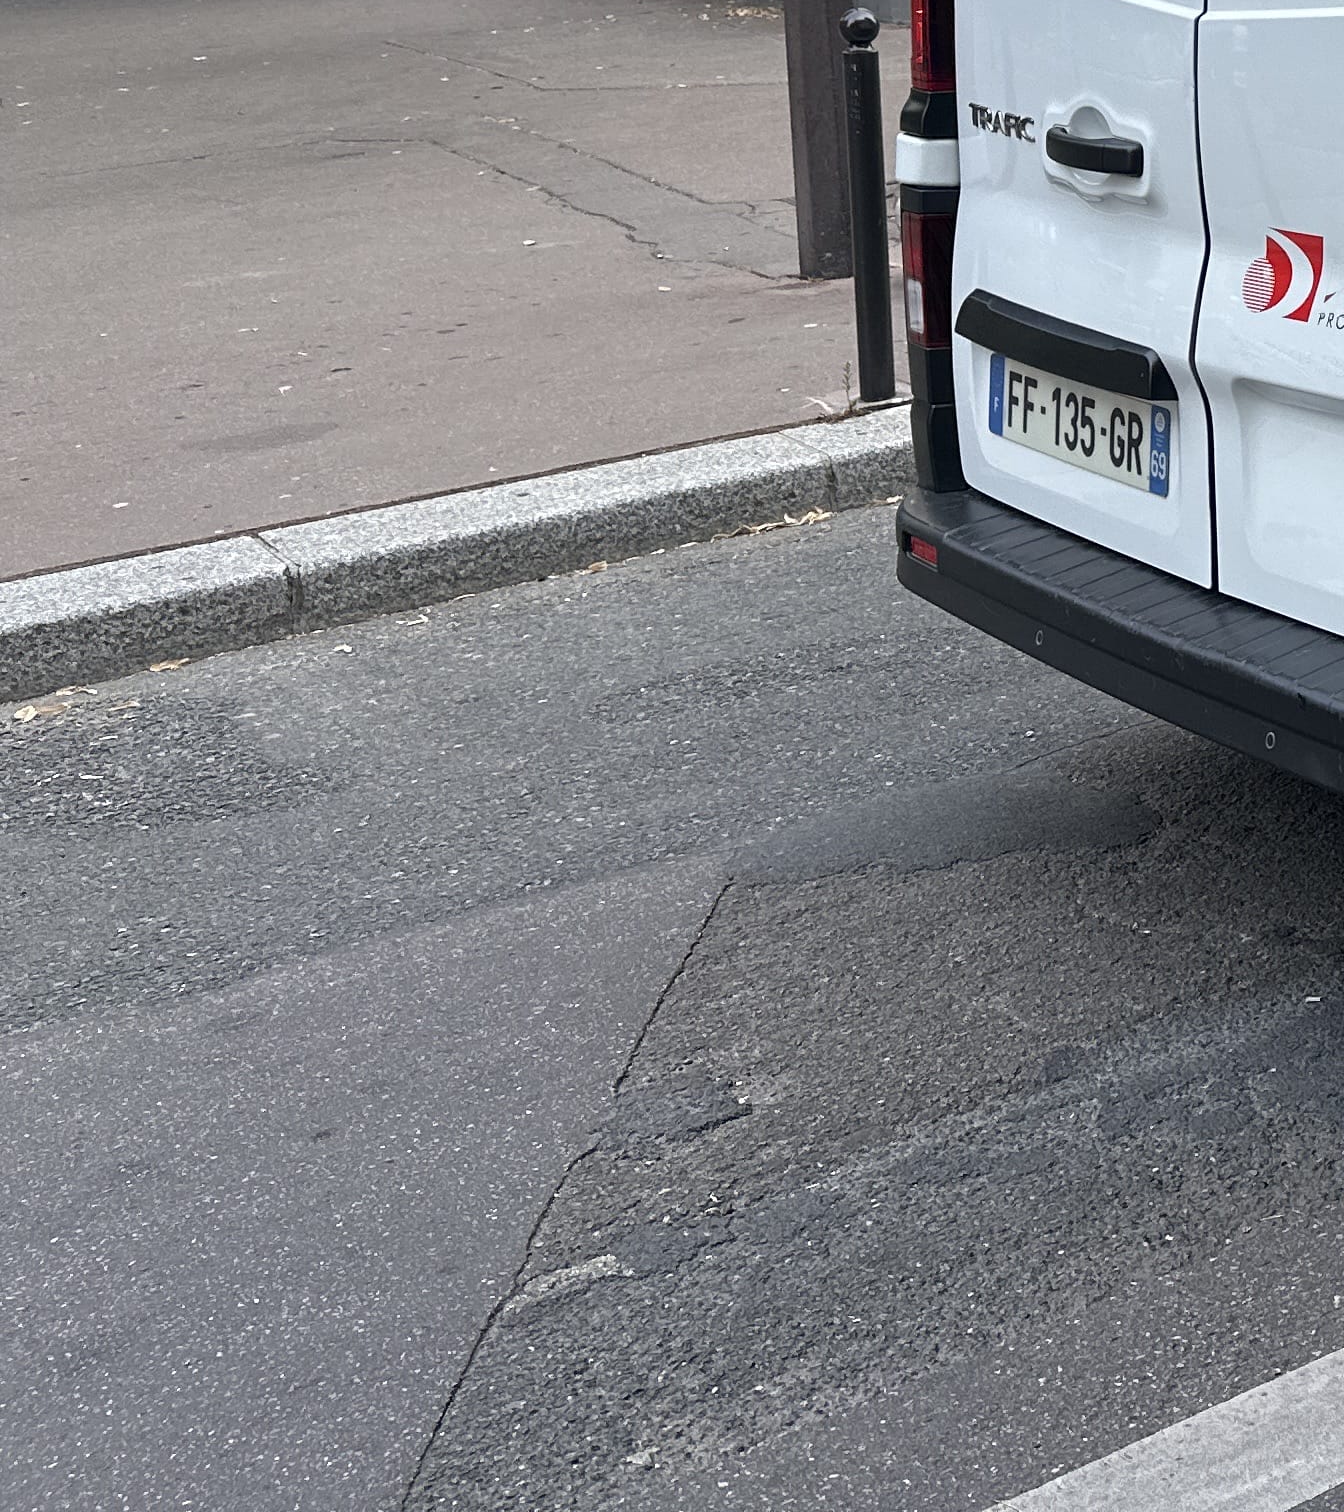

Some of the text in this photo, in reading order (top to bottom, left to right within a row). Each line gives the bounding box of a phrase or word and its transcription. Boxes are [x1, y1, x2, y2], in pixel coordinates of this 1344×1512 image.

[968, 102, 1036, 143] TRAFIC
[1007, 370, 1142, 476] FF-135-GR
[1150, 449, 1167, 481] 69
